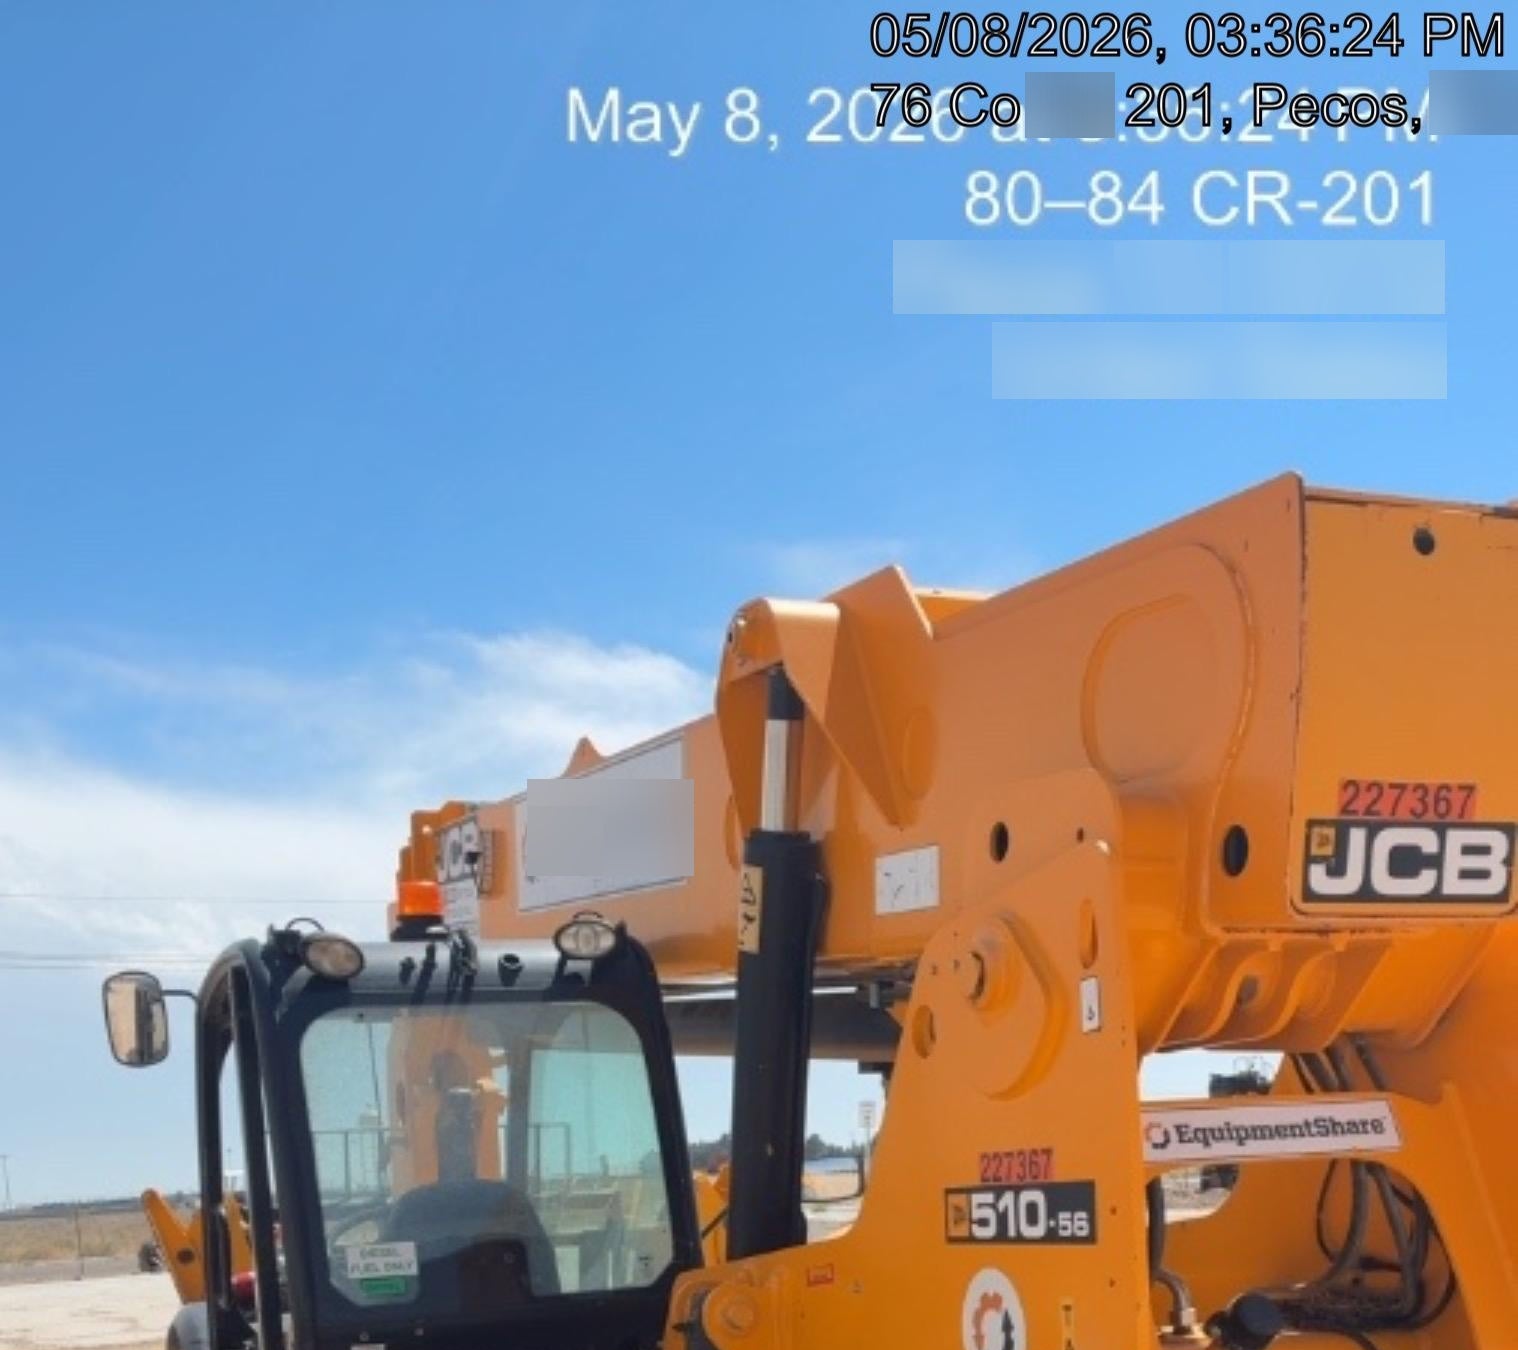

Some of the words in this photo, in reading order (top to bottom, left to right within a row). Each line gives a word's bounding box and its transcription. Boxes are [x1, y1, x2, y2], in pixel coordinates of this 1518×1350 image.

[1340, 779, 1477, 821] 227367
[1308, 827, 1509, 896] JCB
[1173, 1115, 1386, 1147] EquipmentShare
[979, 1147, 1054, 1183] 227367
